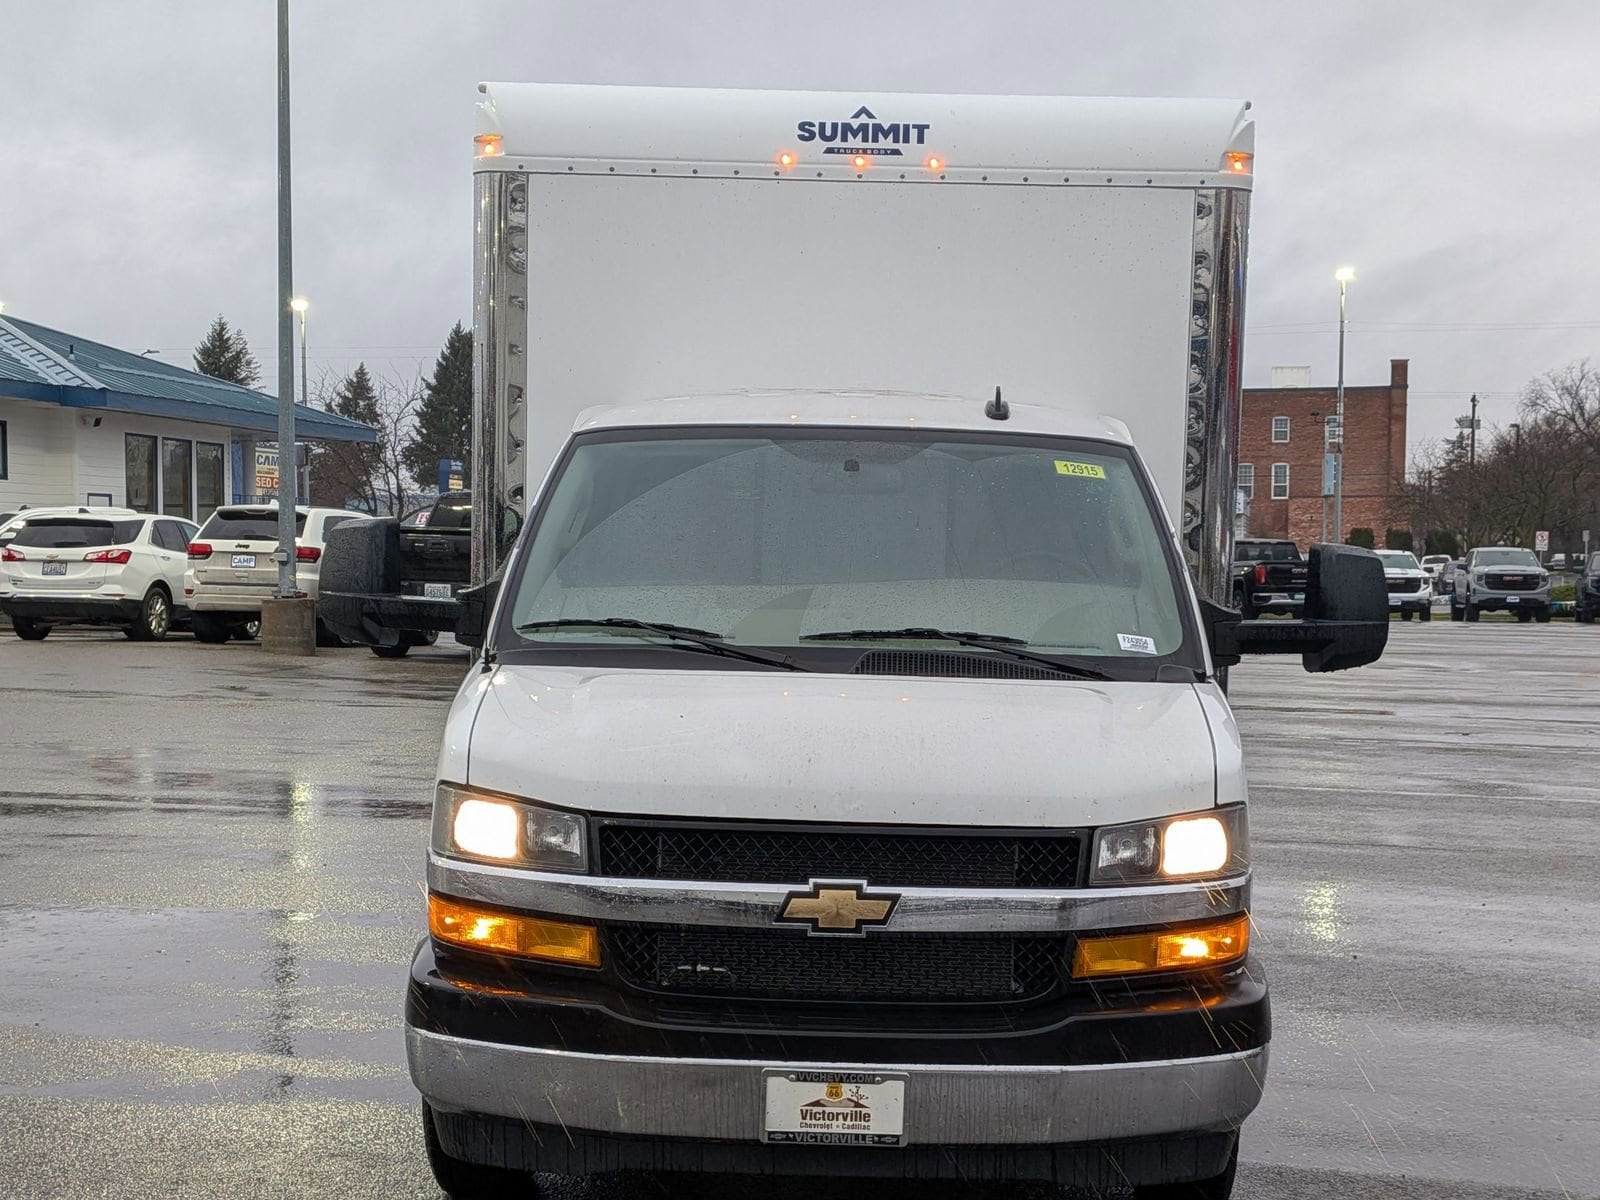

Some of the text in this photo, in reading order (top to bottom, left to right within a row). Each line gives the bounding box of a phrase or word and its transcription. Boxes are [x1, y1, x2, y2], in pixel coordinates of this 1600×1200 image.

[797, 121, 930, 144] SUMMIT
[257, 454, 279, 466] CAM
[1063, 463, 1098, 476] 12915
[255, 476, 272, 488] SED
[232, 557, 254, 565] CAMP
[799, 1071, 874, 1084] VVCHEVY.COM
[828, 1089, 840, 1098] 66
[800, 1108, 871, 1123] Victorville
[799, 1121, 871, 1131] Chevrolet Cadillac
[795, 1132, 873, 1145] VICTORVILLE
